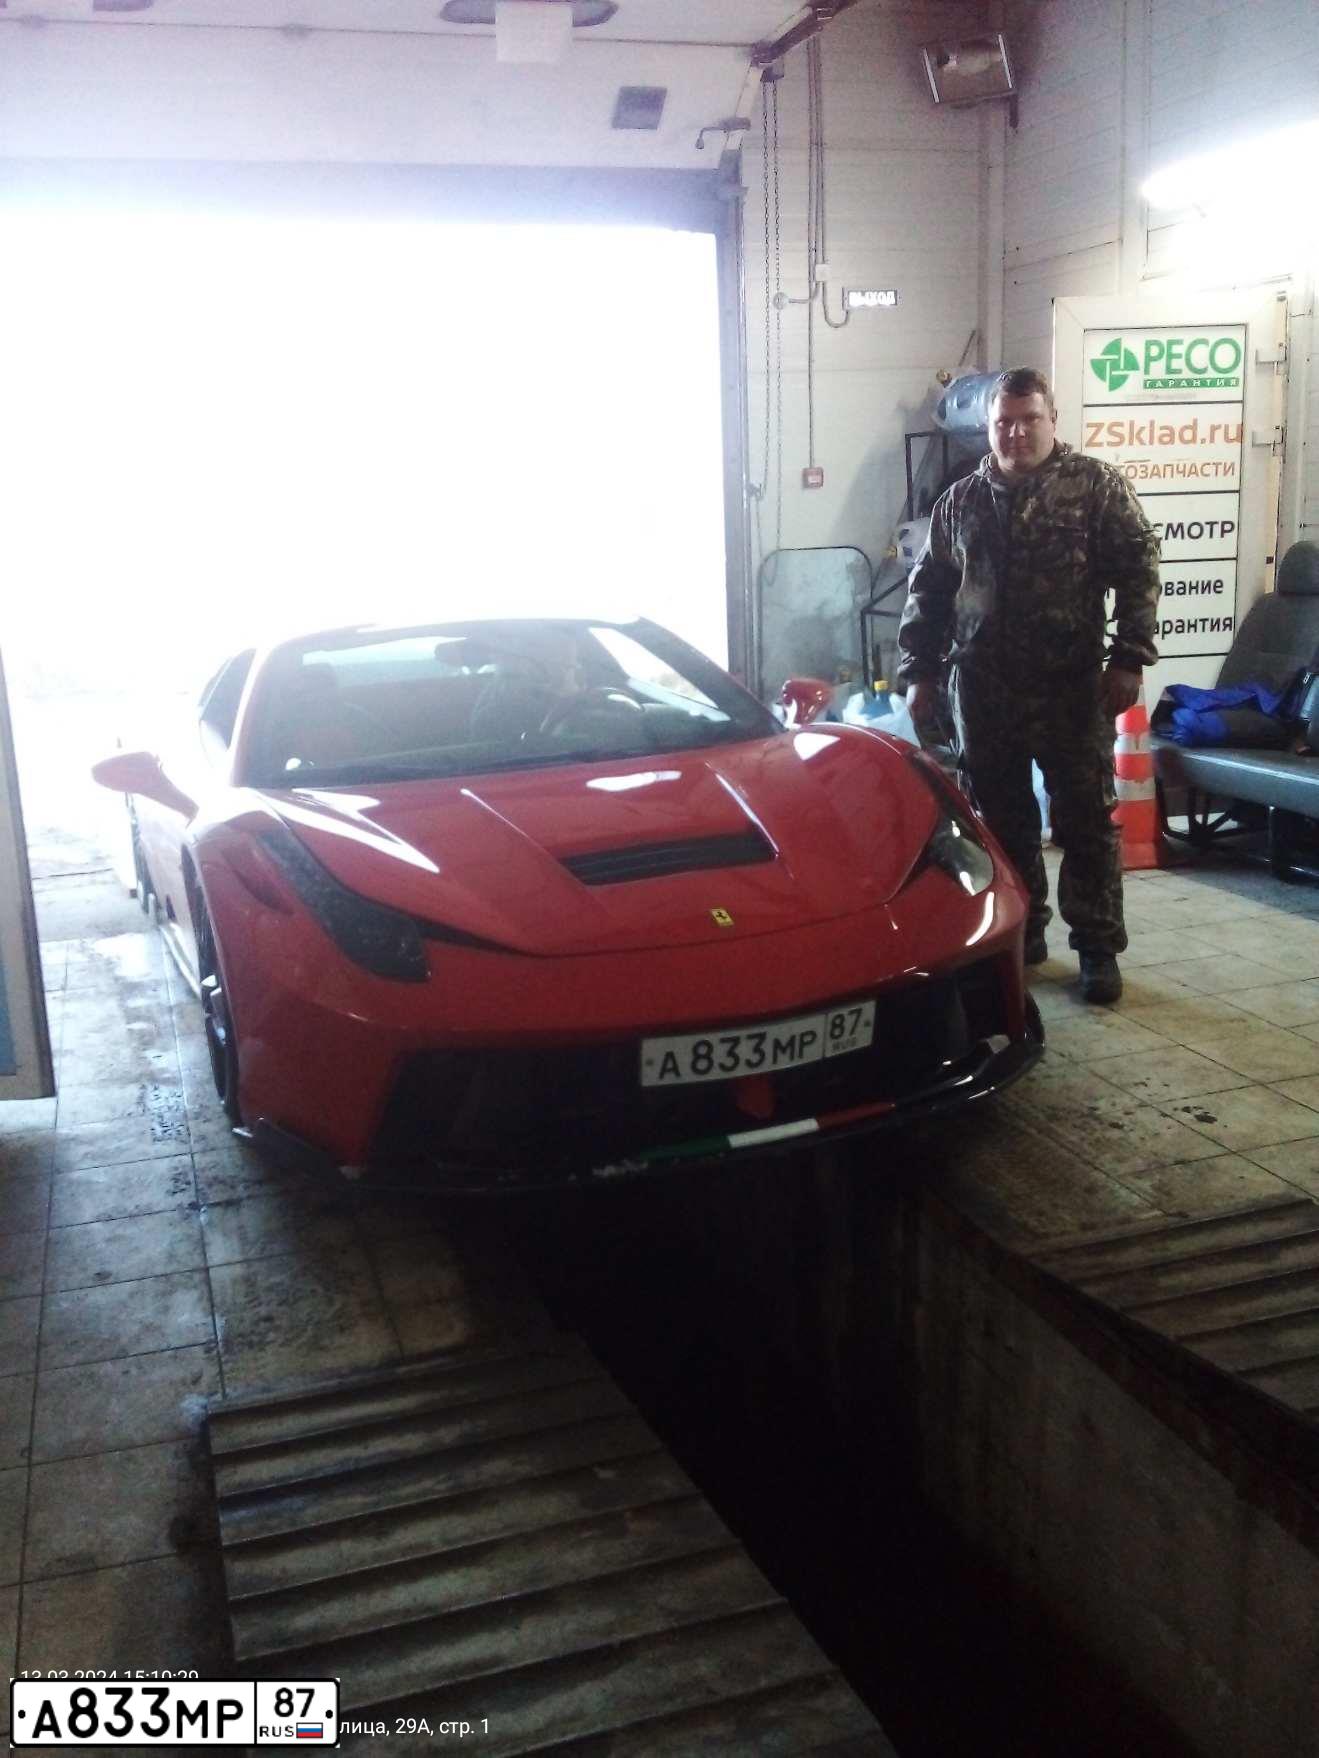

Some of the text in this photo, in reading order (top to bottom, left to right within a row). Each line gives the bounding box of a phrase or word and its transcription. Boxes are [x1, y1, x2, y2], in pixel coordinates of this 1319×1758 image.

[1144, 338, 1242, 375] РЕСО
[1145, 377, 1238, 388] ГАРАНТИЯ
[1085, 418, 1243, 448] ZSklad.ru
[1159, 579, 1224, 596] вание
